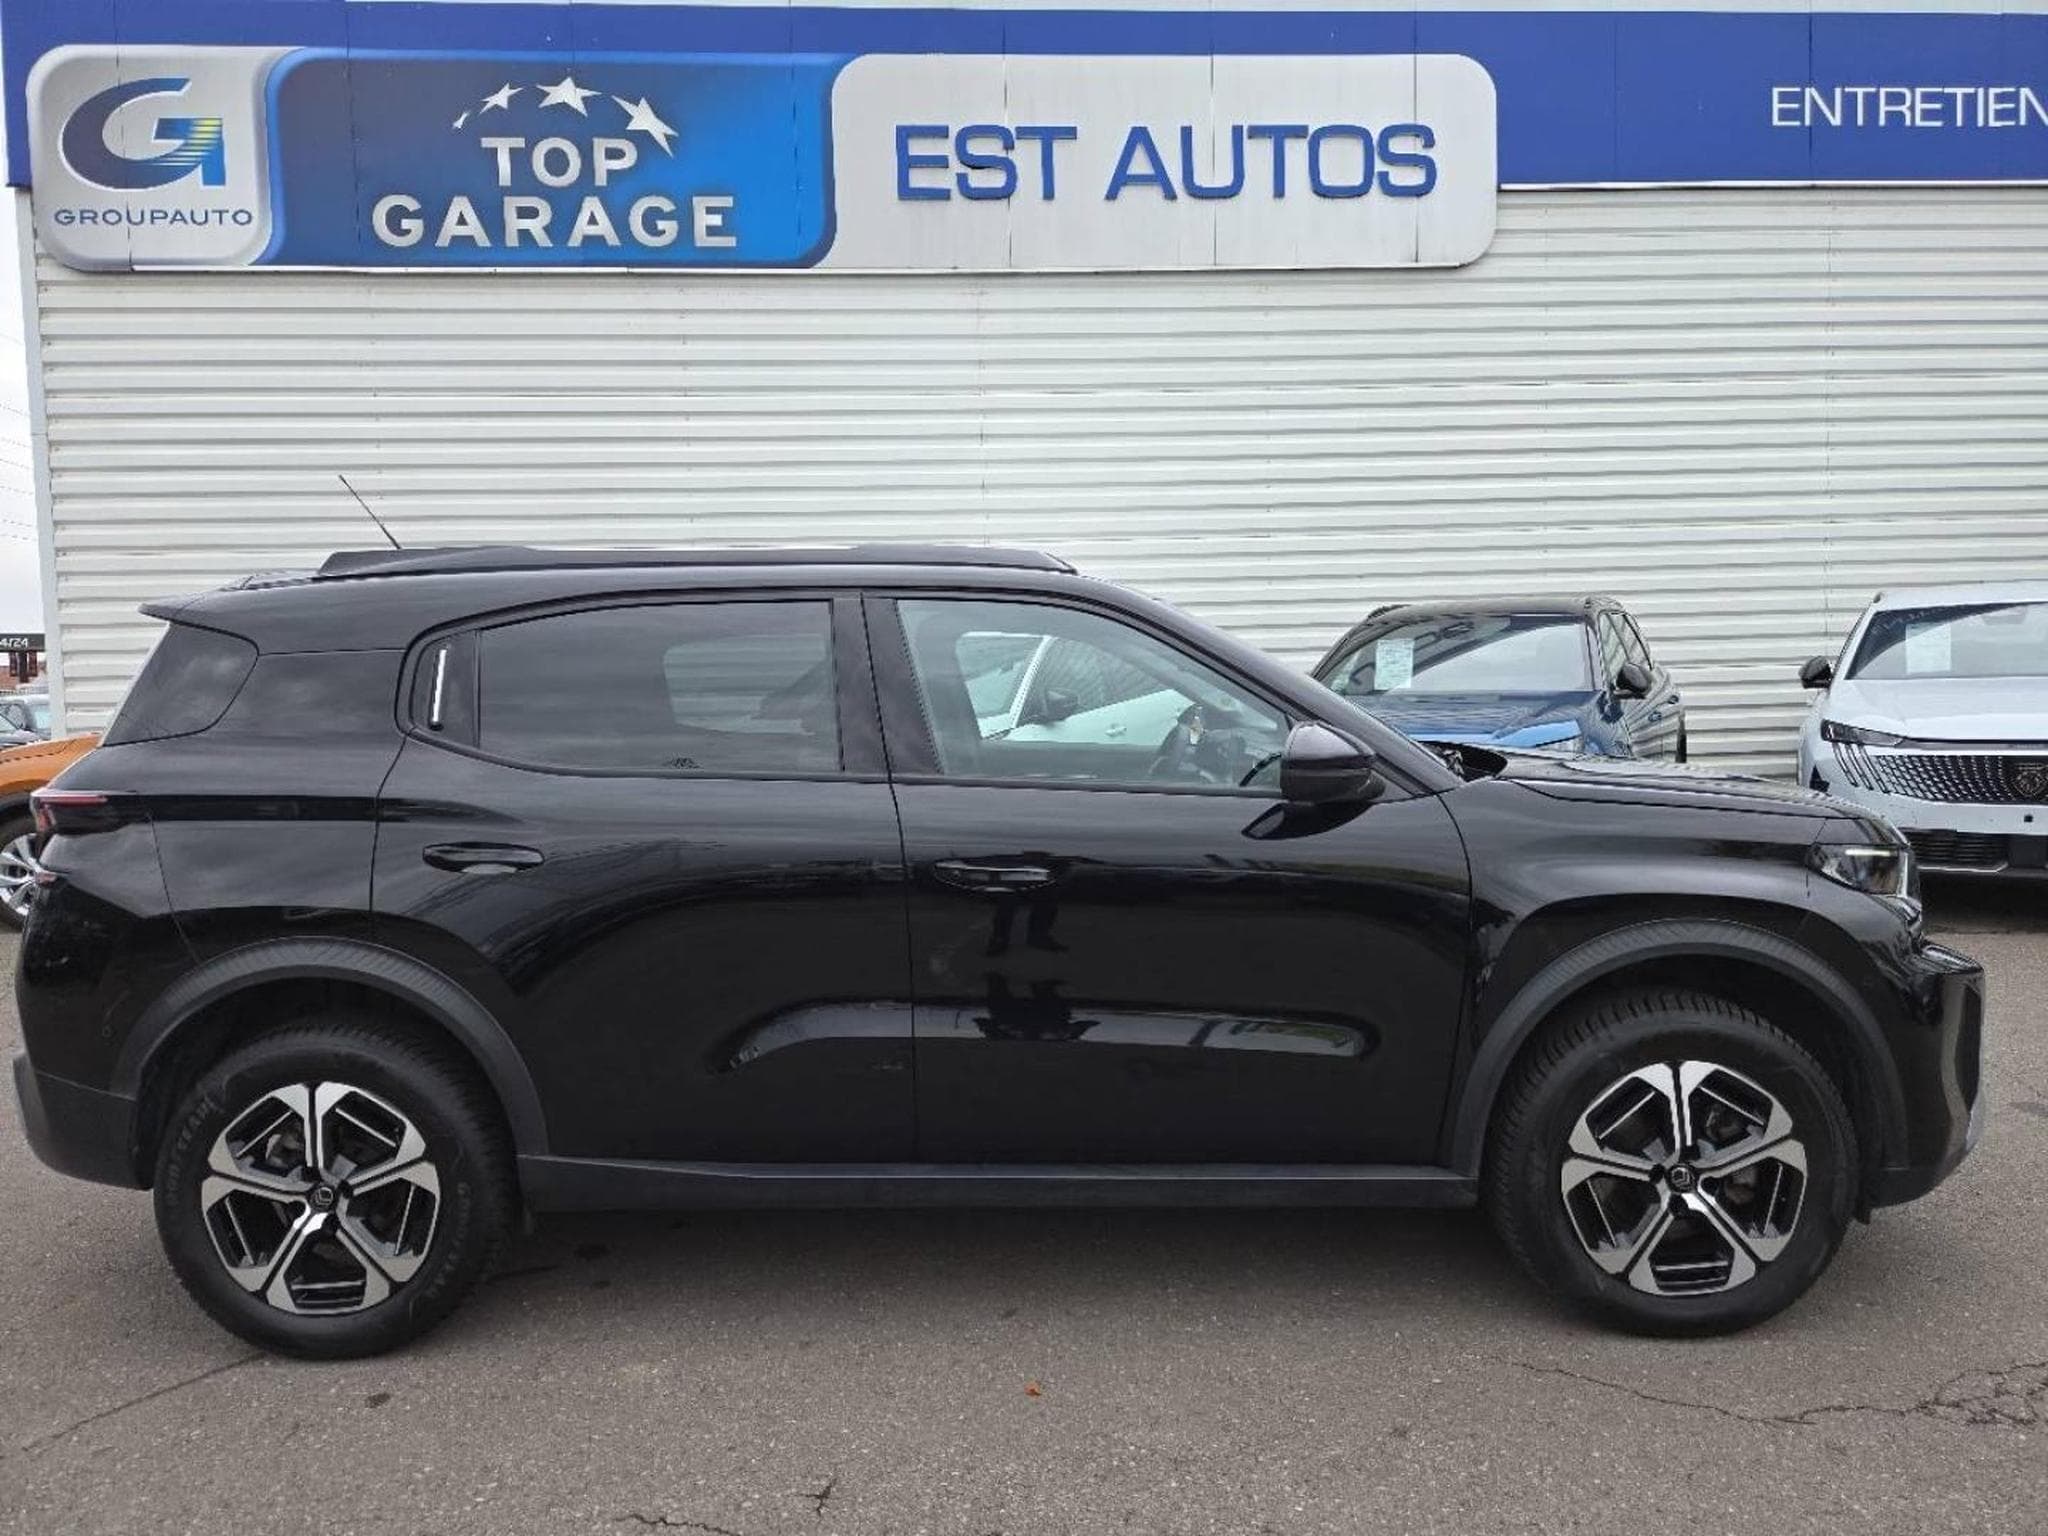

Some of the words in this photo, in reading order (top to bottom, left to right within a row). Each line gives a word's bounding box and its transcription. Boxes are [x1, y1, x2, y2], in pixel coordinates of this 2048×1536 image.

[1771, 86, 2048, 127] ENTRETIEN
[480, 136, 638, 187] TOP
[896, 125, 1077, 201] EST
[1104, 124, 1438, 201] AUTOS
[54, 208, 254, 227] GROUPAUTO
[372, 195, 738, 249] GARAGE
